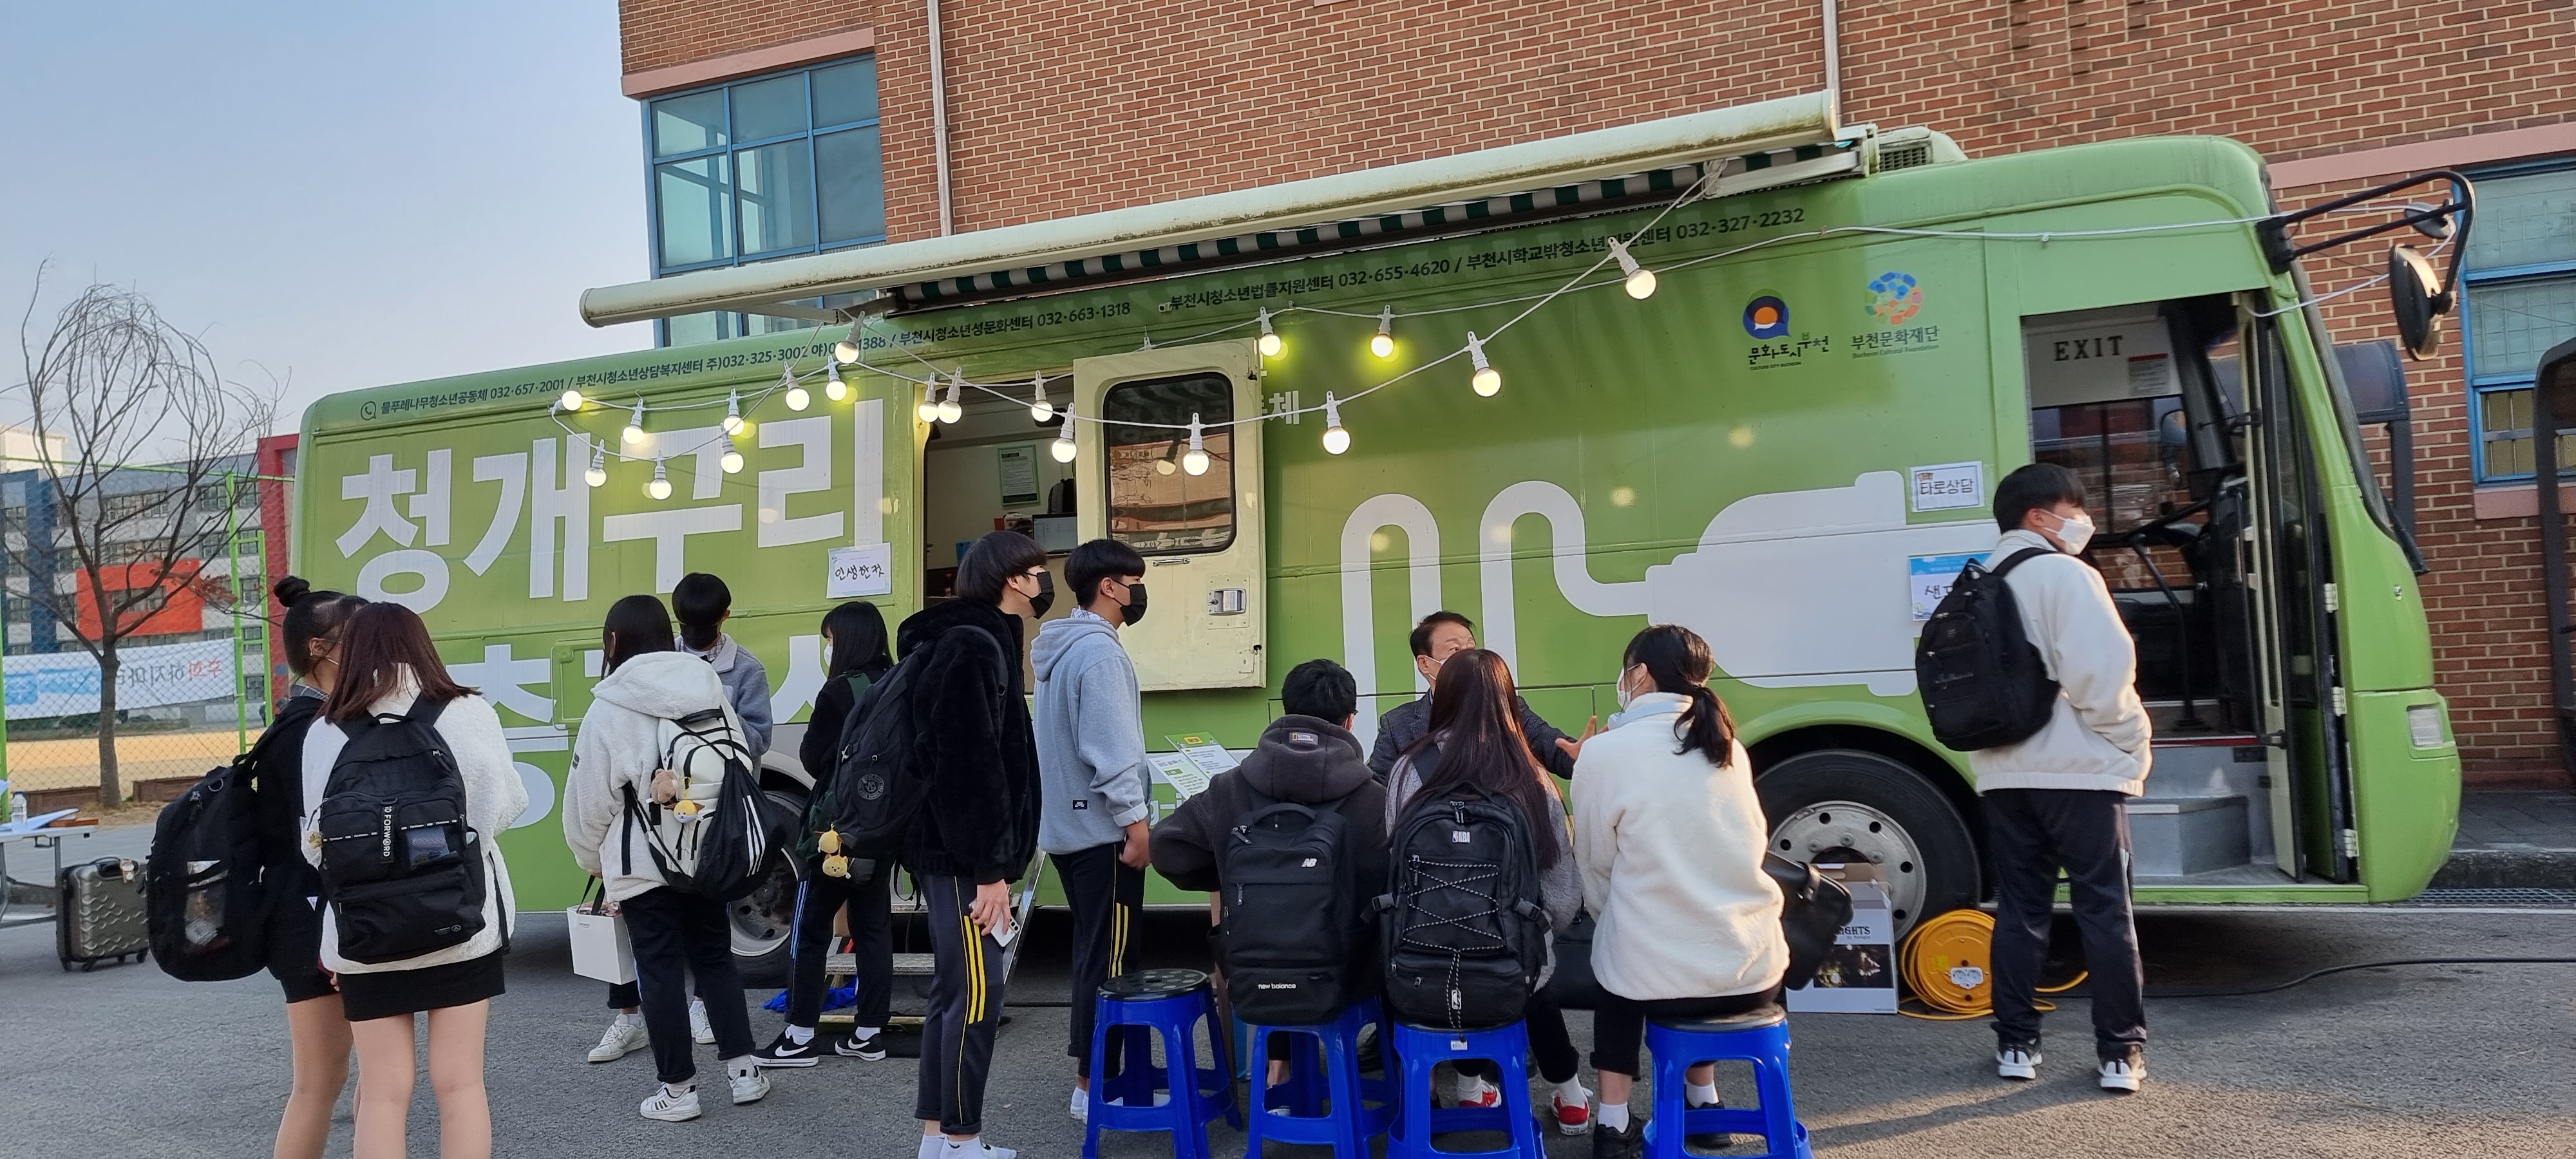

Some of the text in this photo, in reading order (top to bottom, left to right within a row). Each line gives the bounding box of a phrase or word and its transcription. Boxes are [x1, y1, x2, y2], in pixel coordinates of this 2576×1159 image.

[575, 359, 703, 388] 부천시청소년상담복지센터
[899, 315, 1034, 346] 부천시청소년성문화센터
[1170, 274, 1334, 309] 부천시청소년법률지원센터
[1850, 325, 1940, 350] 부천문화재단
[2054, 335, 2123, 361] EXIT
[1920, 478, 1975, 495] 타로상담
[335, 399, 884, 614] 청개구리
[1840, 926, 1871, 935] IGHTS
